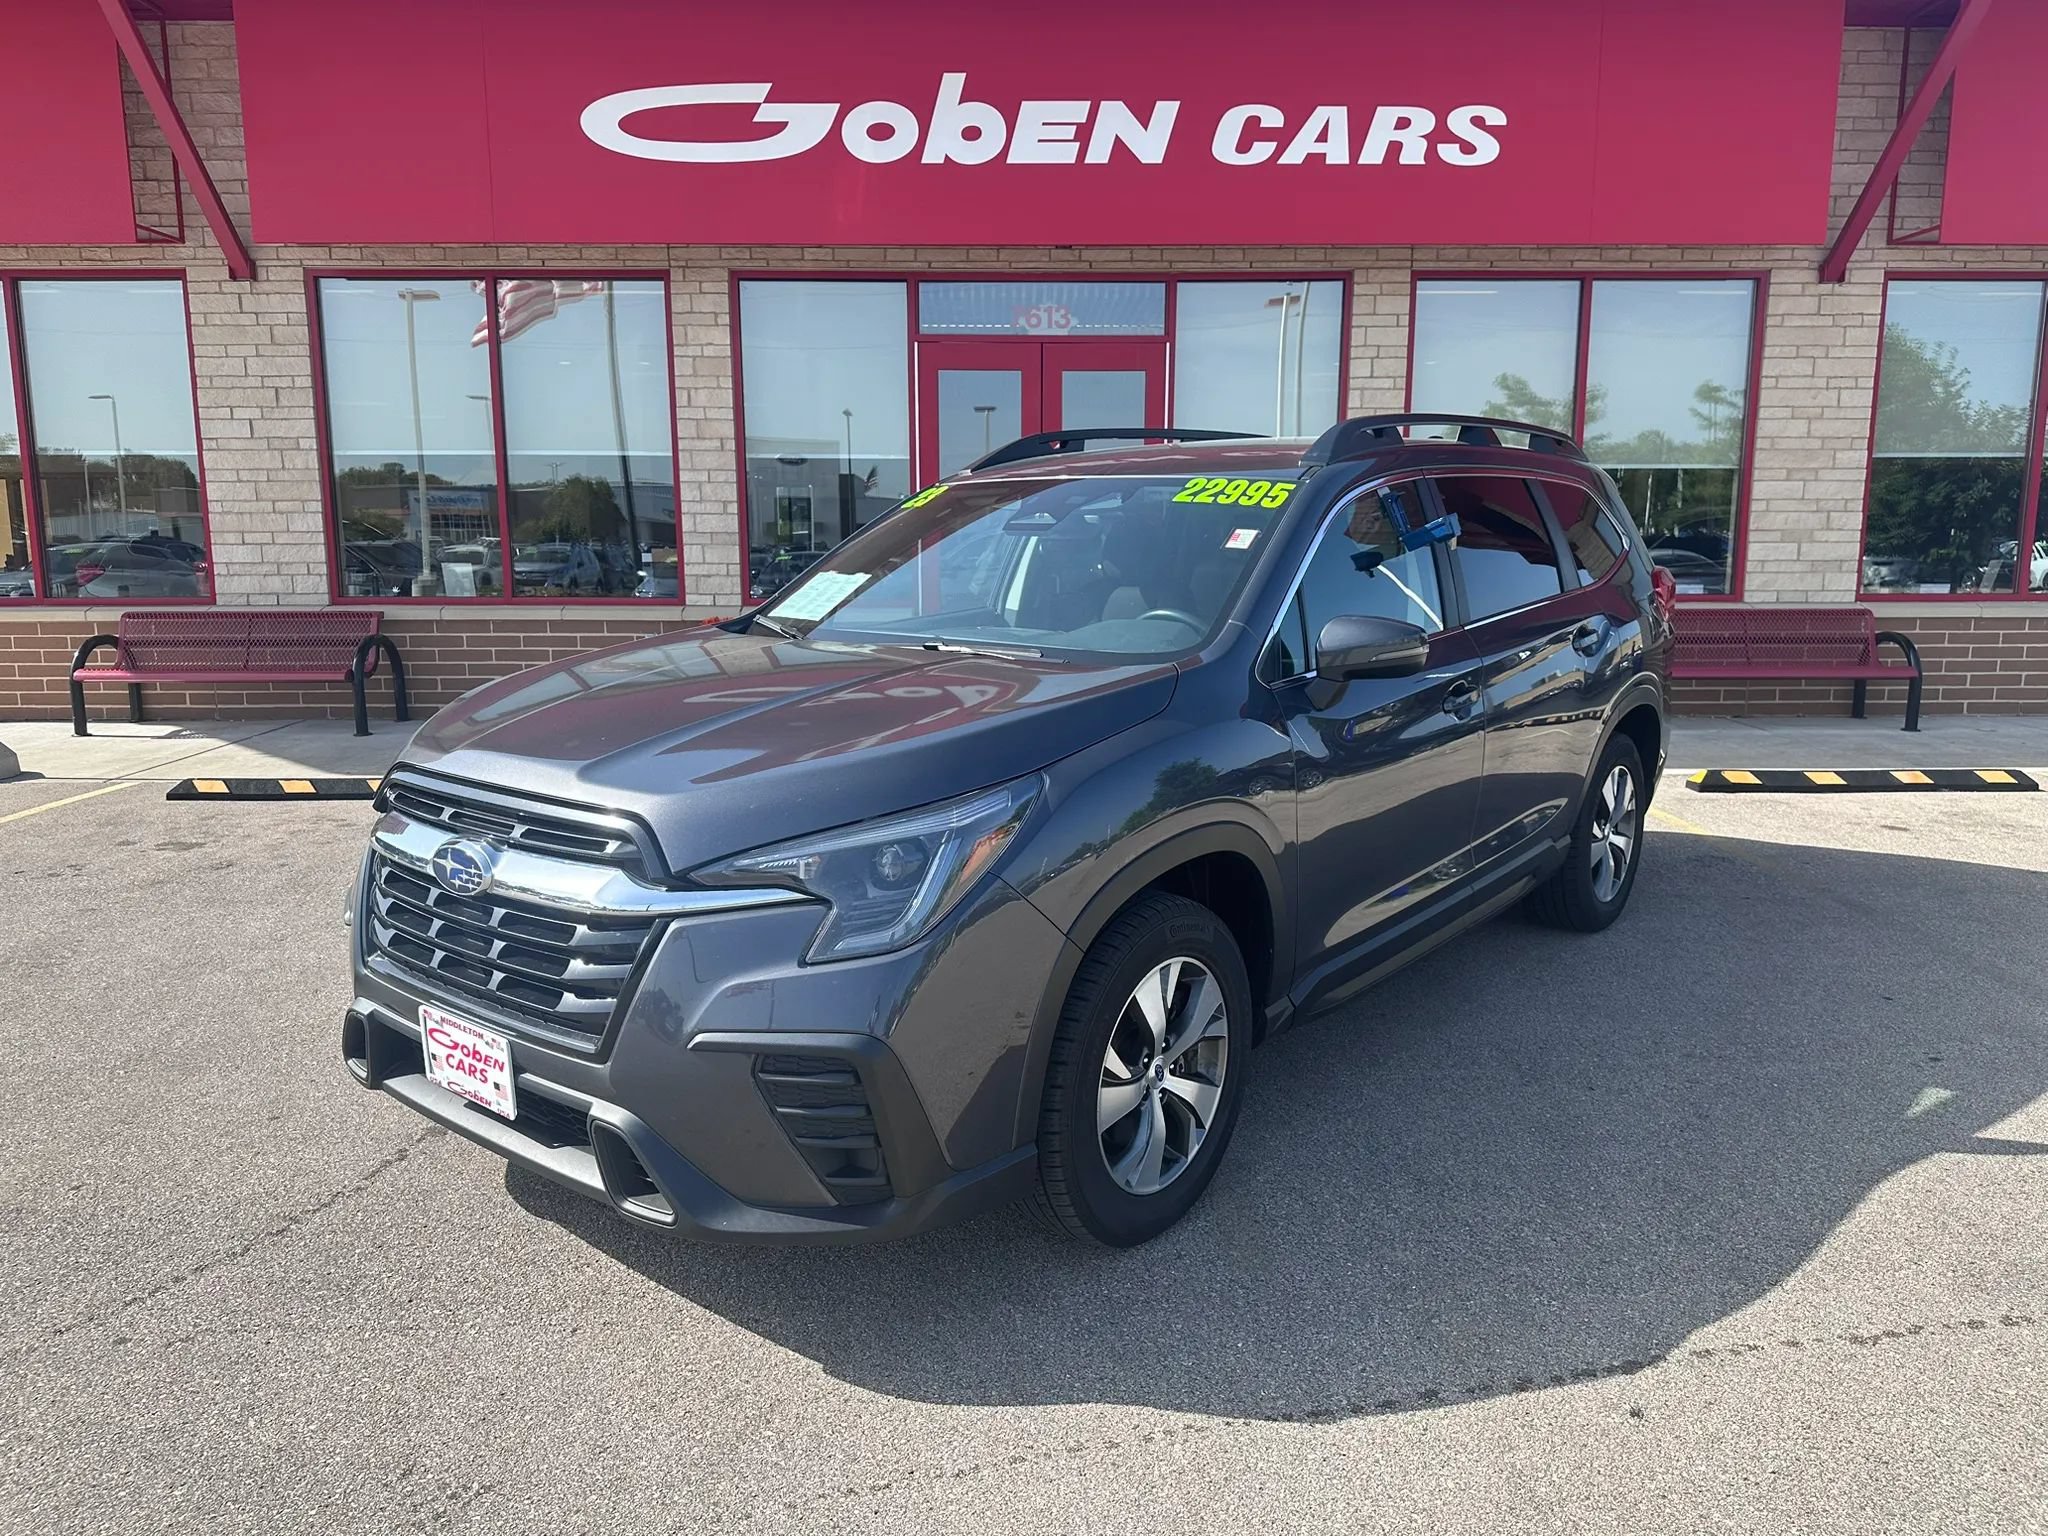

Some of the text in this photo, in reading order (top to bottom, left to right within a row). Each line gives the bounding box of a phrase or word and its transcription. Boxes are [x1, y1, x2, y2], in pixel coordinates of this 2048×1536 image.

[1211, 104, 1508, 166] CARS
[1172, 477, 1297, 508] 22995
[440, 1015, 485, 1040] MIDDLETON
[445, 1053, 489, 1084] CARS
